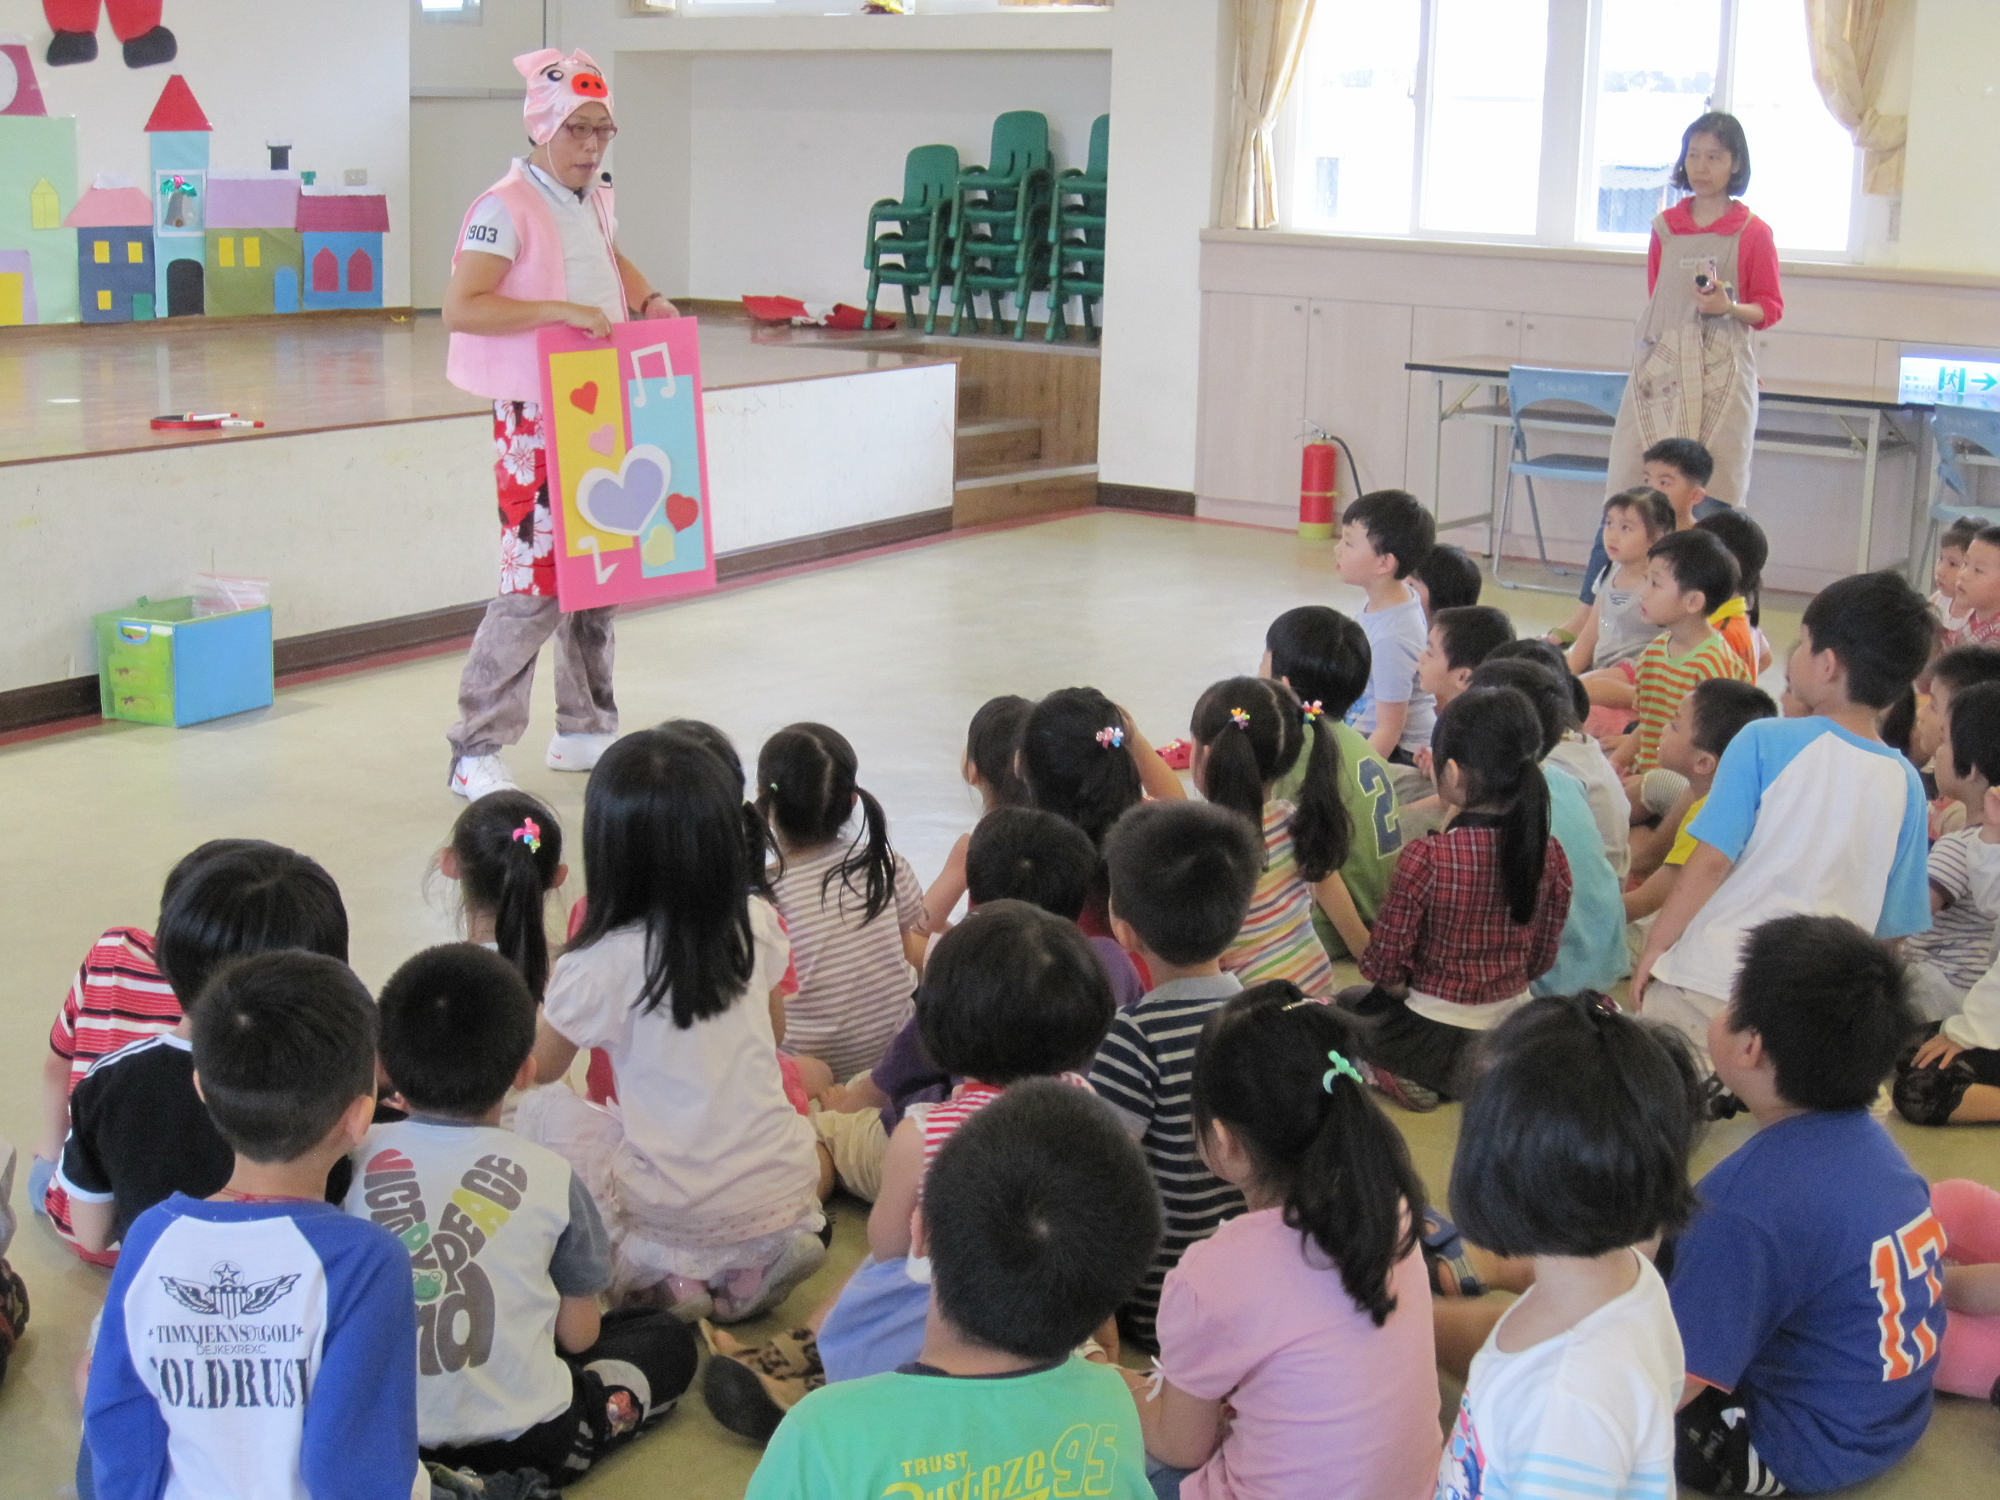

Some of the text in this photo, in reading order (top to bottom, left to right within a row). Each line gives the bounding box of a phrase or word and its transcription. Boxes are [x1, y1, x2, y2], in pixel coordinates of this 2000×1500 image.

[1357, 755, 1402, 860] 2
[431, 1154, 528, 1296] PEACE
[1869, 1206, 1948, 1382] 17
[150, 1356, 308, 1409] OLDRUS
[901, 1451, 968, 1478] TRUST
[1050, 1423, 1119, 1498] 95
